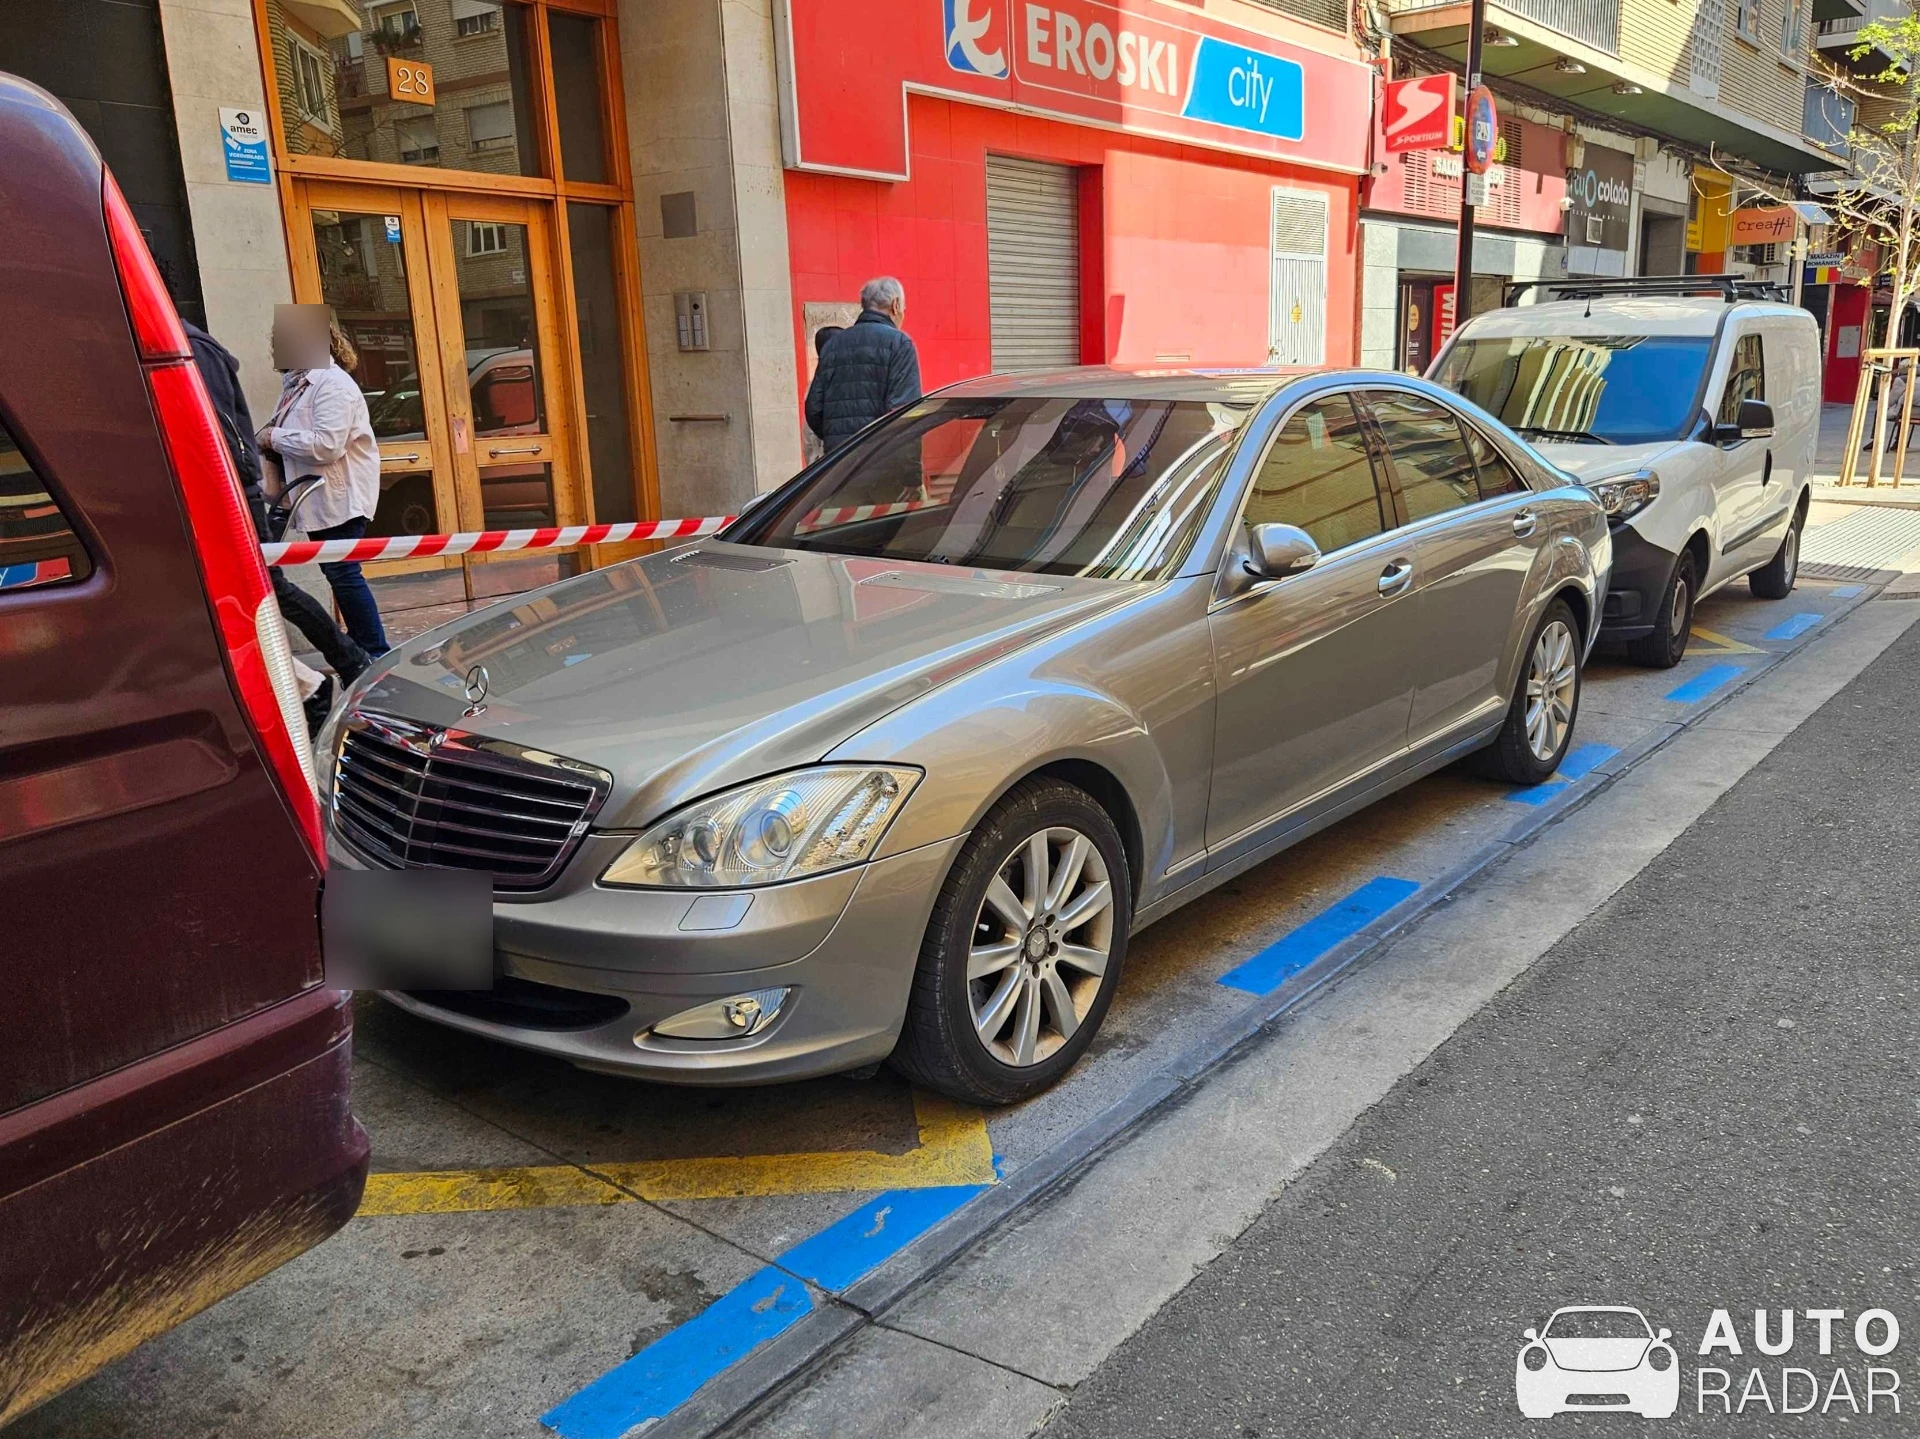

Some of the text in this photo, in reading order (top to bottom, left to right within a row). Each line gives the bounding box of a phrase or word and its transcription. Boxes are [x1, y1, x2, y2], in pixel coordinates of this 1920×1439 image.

[1026, 3, 1274, 124] EROSKI city
[398, 67, 429, 95] 28
[230, 125, 258, 135] amec
[1391, 131, 1444, 148] SPORTIUM
[1597, 177, 1629, 206] colada
